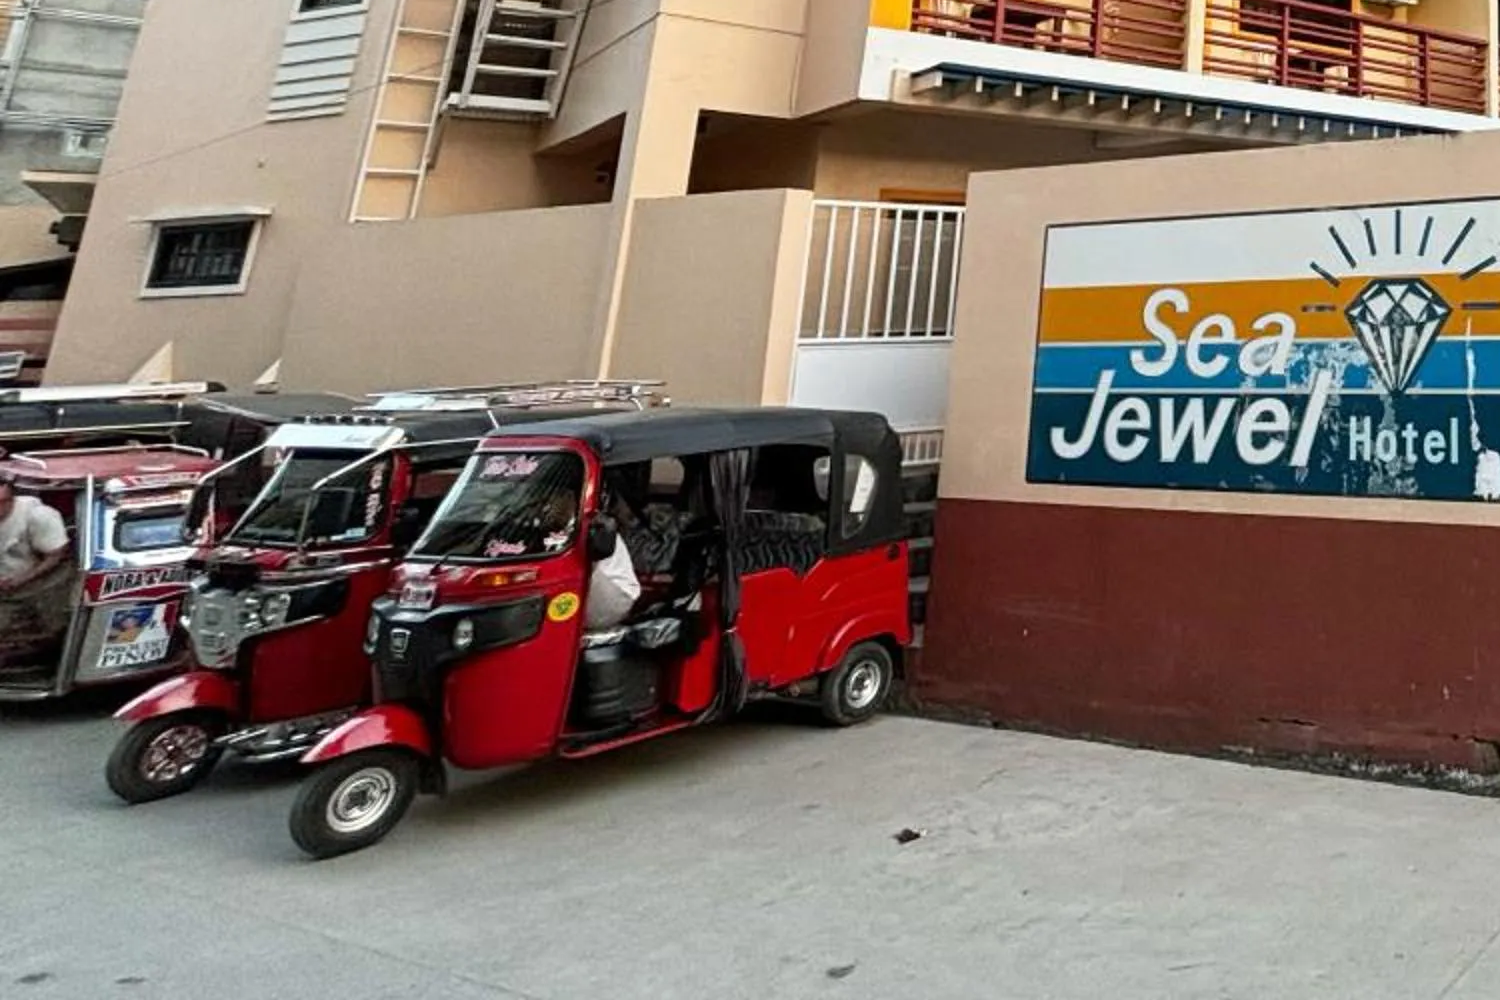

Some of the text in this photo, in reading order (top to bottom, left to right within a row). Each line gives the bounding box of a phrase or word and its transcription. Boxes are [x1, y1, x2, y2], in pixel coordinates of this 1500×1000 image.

[1130, 288, 1297, 378] Sea
[1050, 369, 1459, 467] Jewel Hotel
